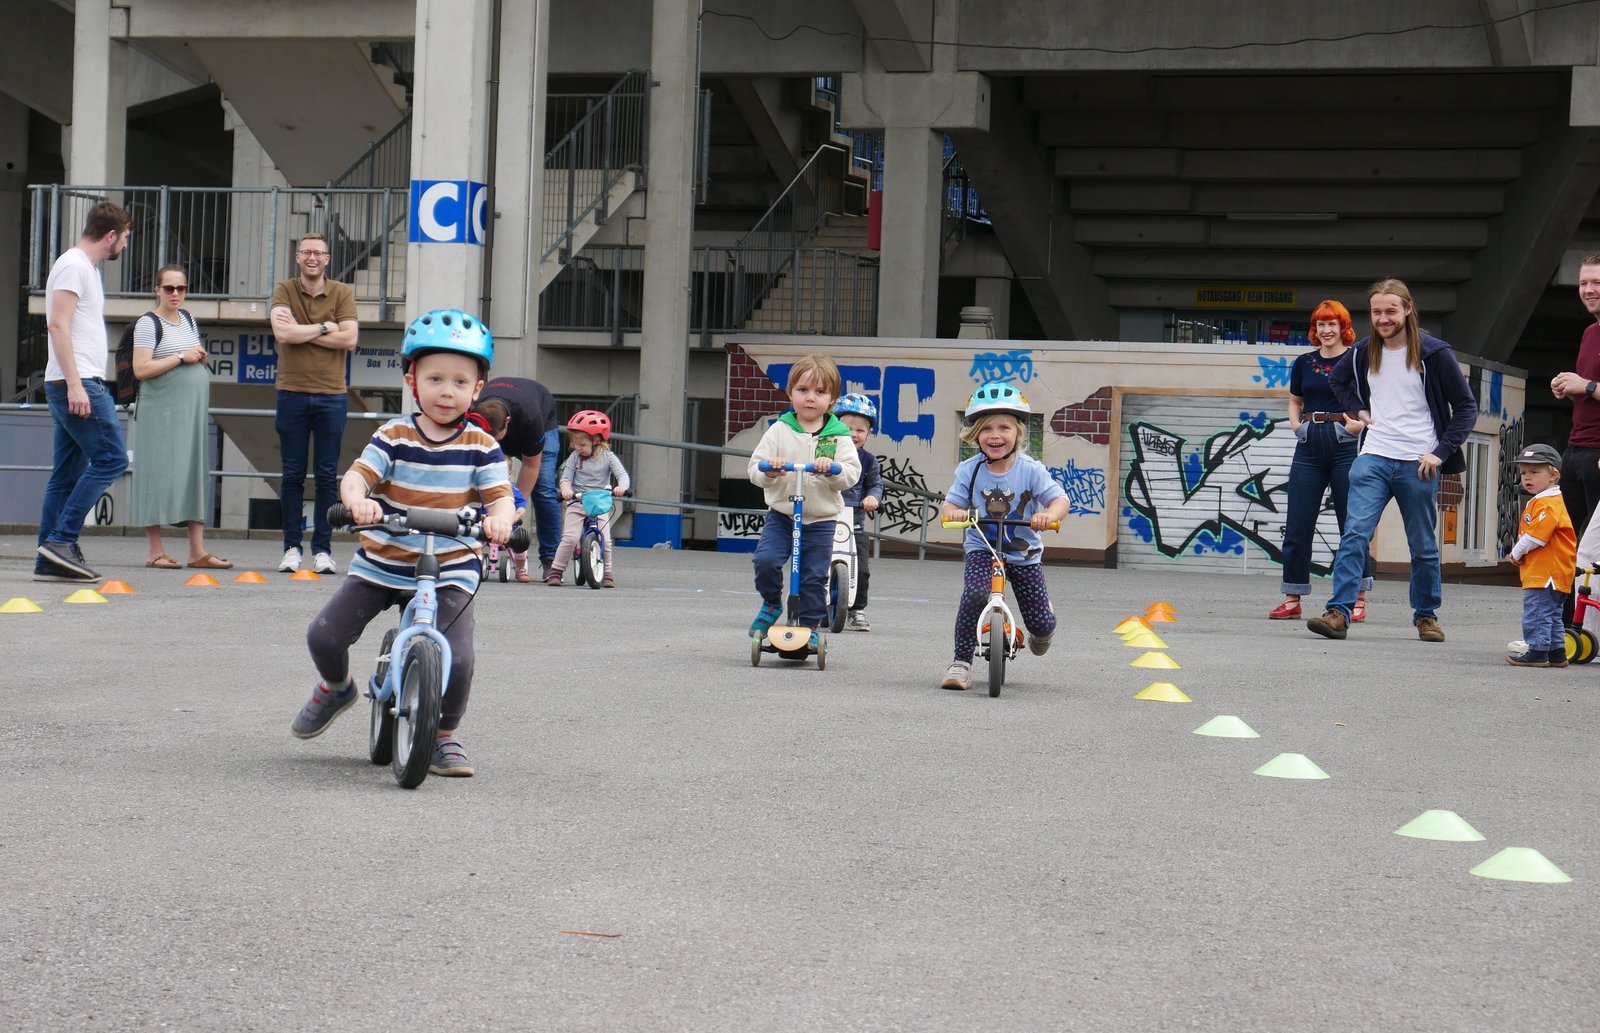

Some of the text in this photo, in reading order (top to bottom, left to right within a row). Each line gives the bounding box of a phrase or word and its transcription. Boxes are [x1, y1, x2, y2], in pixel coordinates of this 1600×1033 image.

[418, 182, 458, 241] C
[1198, 290, 1241, 302] NOTAUSGANG
[1248, 291, 1263, 302] KEIN
[1264, 291, 1293, 303] EINGANG
[355, 346, 399, 357] Panorama-
[367, 359, 402, 368] Box 14-
[246, 364, 278, 379] Reih
[721, 513, 765, 532] ULTRA
[791, 514, 801, 573] GLOBBER
